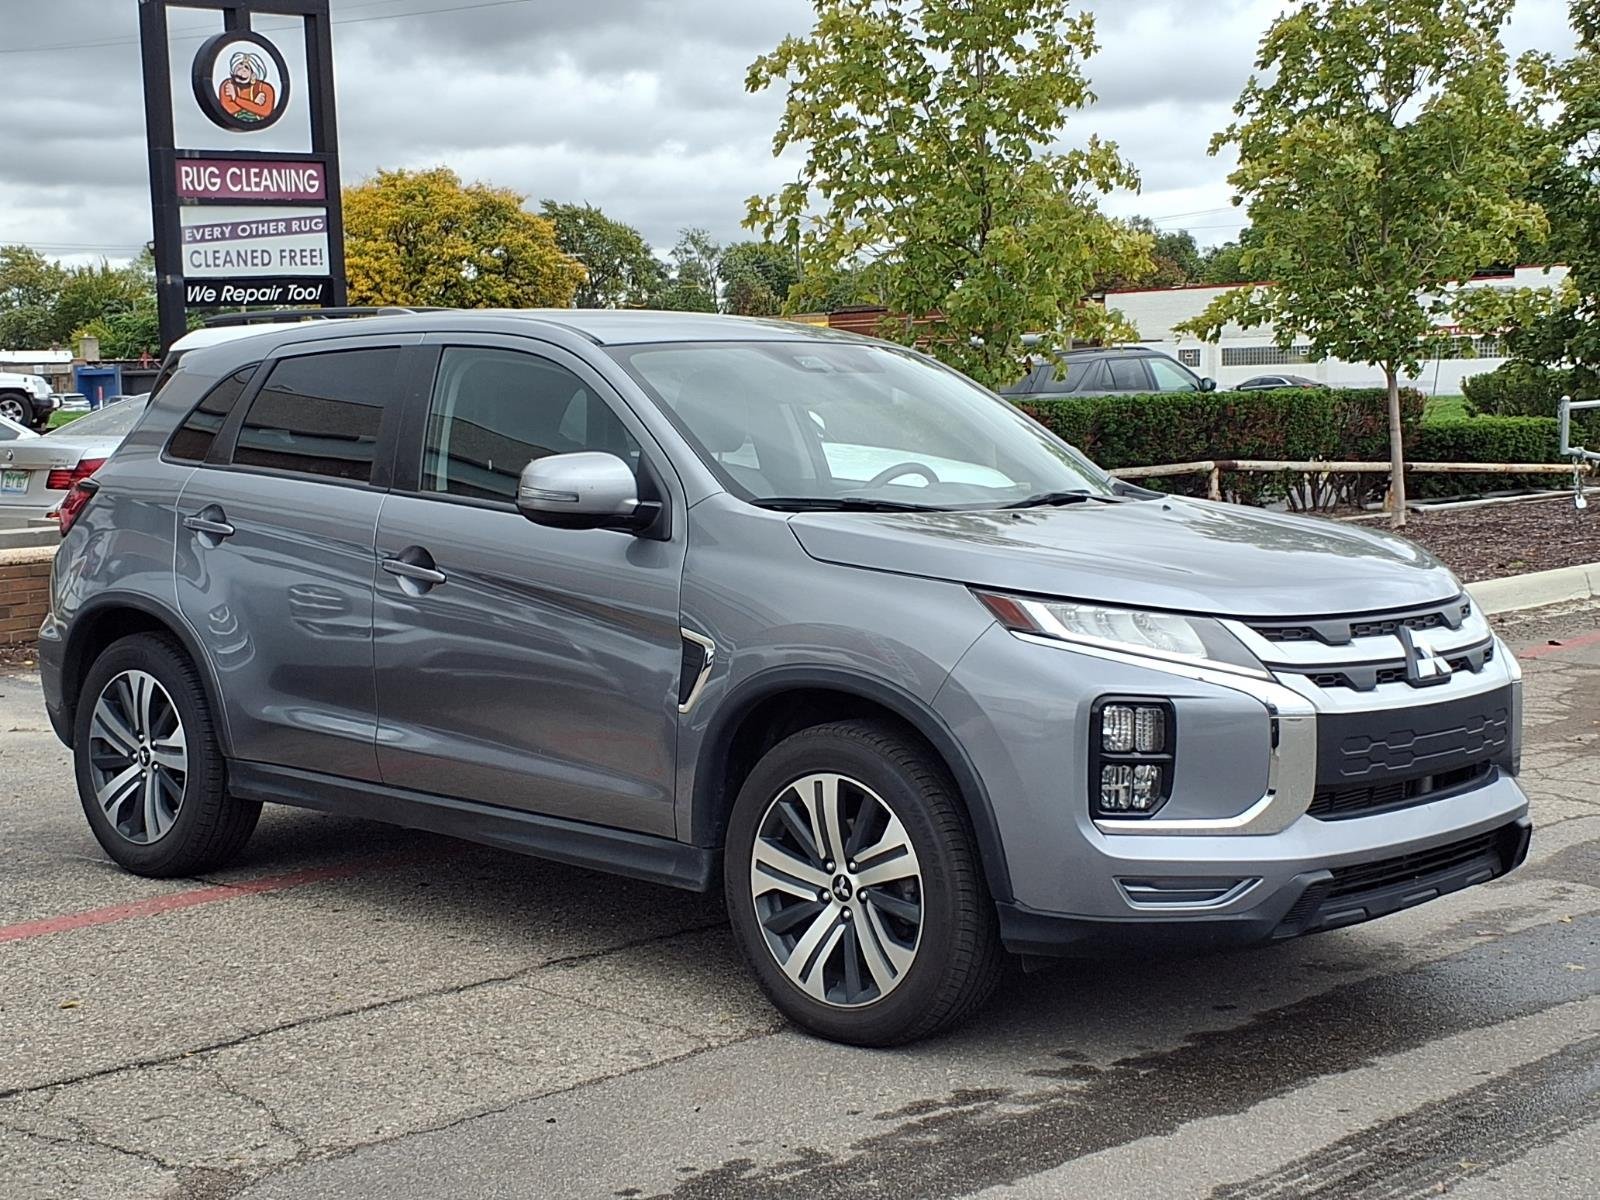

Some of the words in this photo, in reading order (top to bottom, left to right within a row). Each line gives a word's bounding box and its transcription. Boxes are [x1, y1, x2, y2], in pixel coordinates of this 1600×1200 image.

[181, 166, 221, 191] RUG
[226, 167, 320, 193] CLEANING
[185, 225, 232, 241] EVERY
[237, 222, 286, 236] OTHER
[291, 218, 324, 232] RUG
[189, 249, 272, 268] CLEANED
[279, 248, 323, 267] FREE!
[186, 285, 216, 302] We
[220, 284, 282, 304] Repair
[287, 283, 323, 301] Too!
